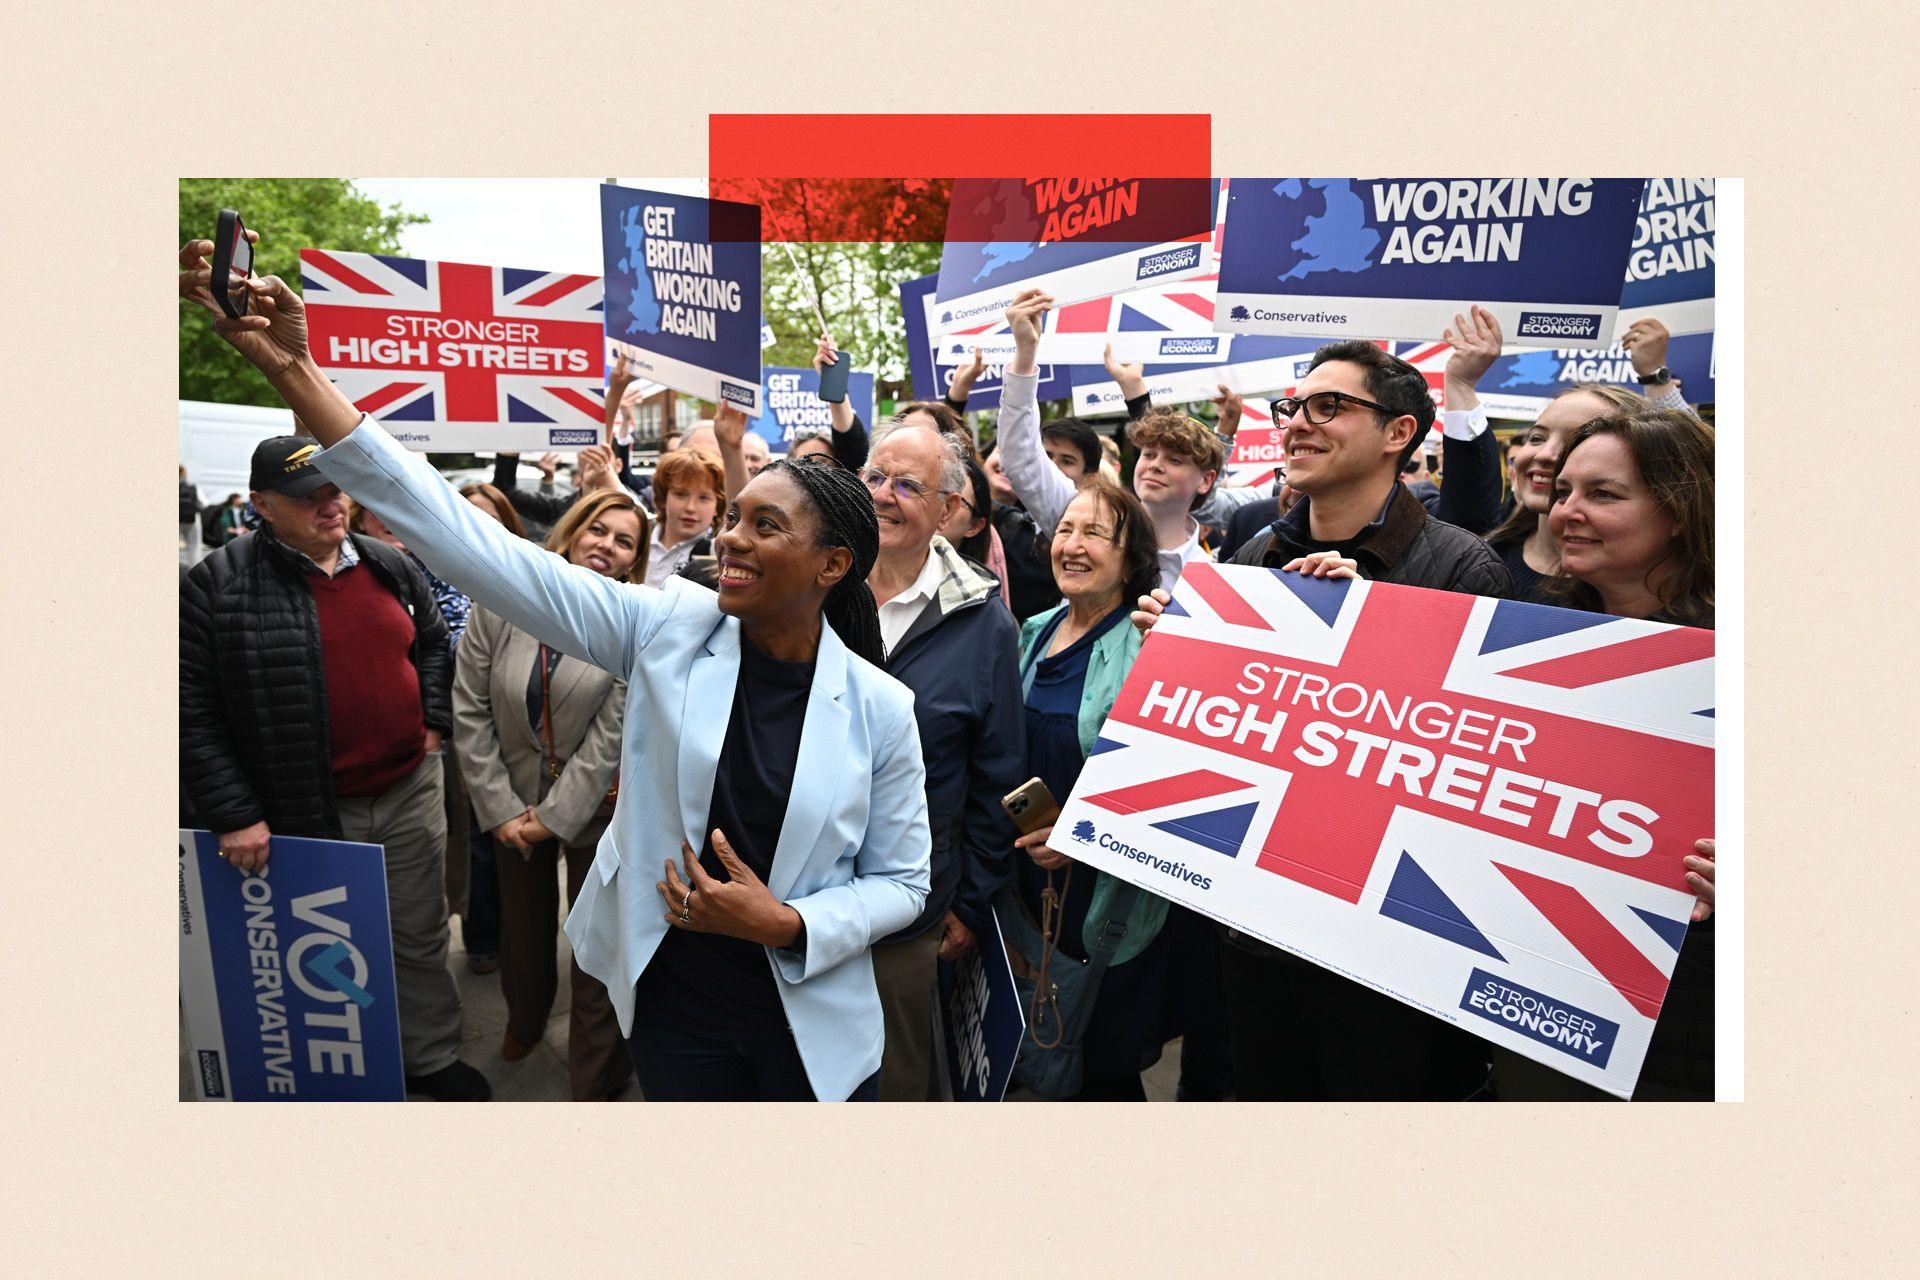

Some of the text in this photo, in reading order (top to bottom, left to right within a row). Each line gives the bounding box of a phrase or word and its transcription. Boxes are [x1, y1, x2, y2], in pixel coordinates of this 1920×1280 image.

[1039, 181, 1139, 248] AGAIN
[1372, 178, 1594, 222] WORKING
[643, 205, 676, 238] GET
[645, 238, 713, 276] BRITAIN
[1144, 249, 1193, 267] STRONGER
[1380, 222, 1524, 265] AGAIN
[1624, 235, 1715, 283] GAIN
[1139, 256, 1197, 277] ECONOMY
[652, 271, 741, 313] WORKING
[387, 315, 540, 343] STRONGER
[661, 304, 717, 342] AGAIN
[1254, 309, 1348, 324] Conservatives
[1521, 324, 1595, 336] ECONOMY
[1528, 316, 1591, 326] STRONGER
[329, 336, 429, 365] HIGH
[437, 341, 590, 372] STREETS
[1161, 345, 1216, 354] ECONOMY
[768, 374, 801, 391] GET
[1236, 662, 1537, 763] STRONGER
[1138, 680, 1660, 859] HIGH STREETS
[1098, 832, 1213, 892] Conservatives
[286, 886, 369, 1077] VOTE
[1469, 990, 1604, 1055] ECONOMY
[1484, 981, 1597, 1037] STRONGER
